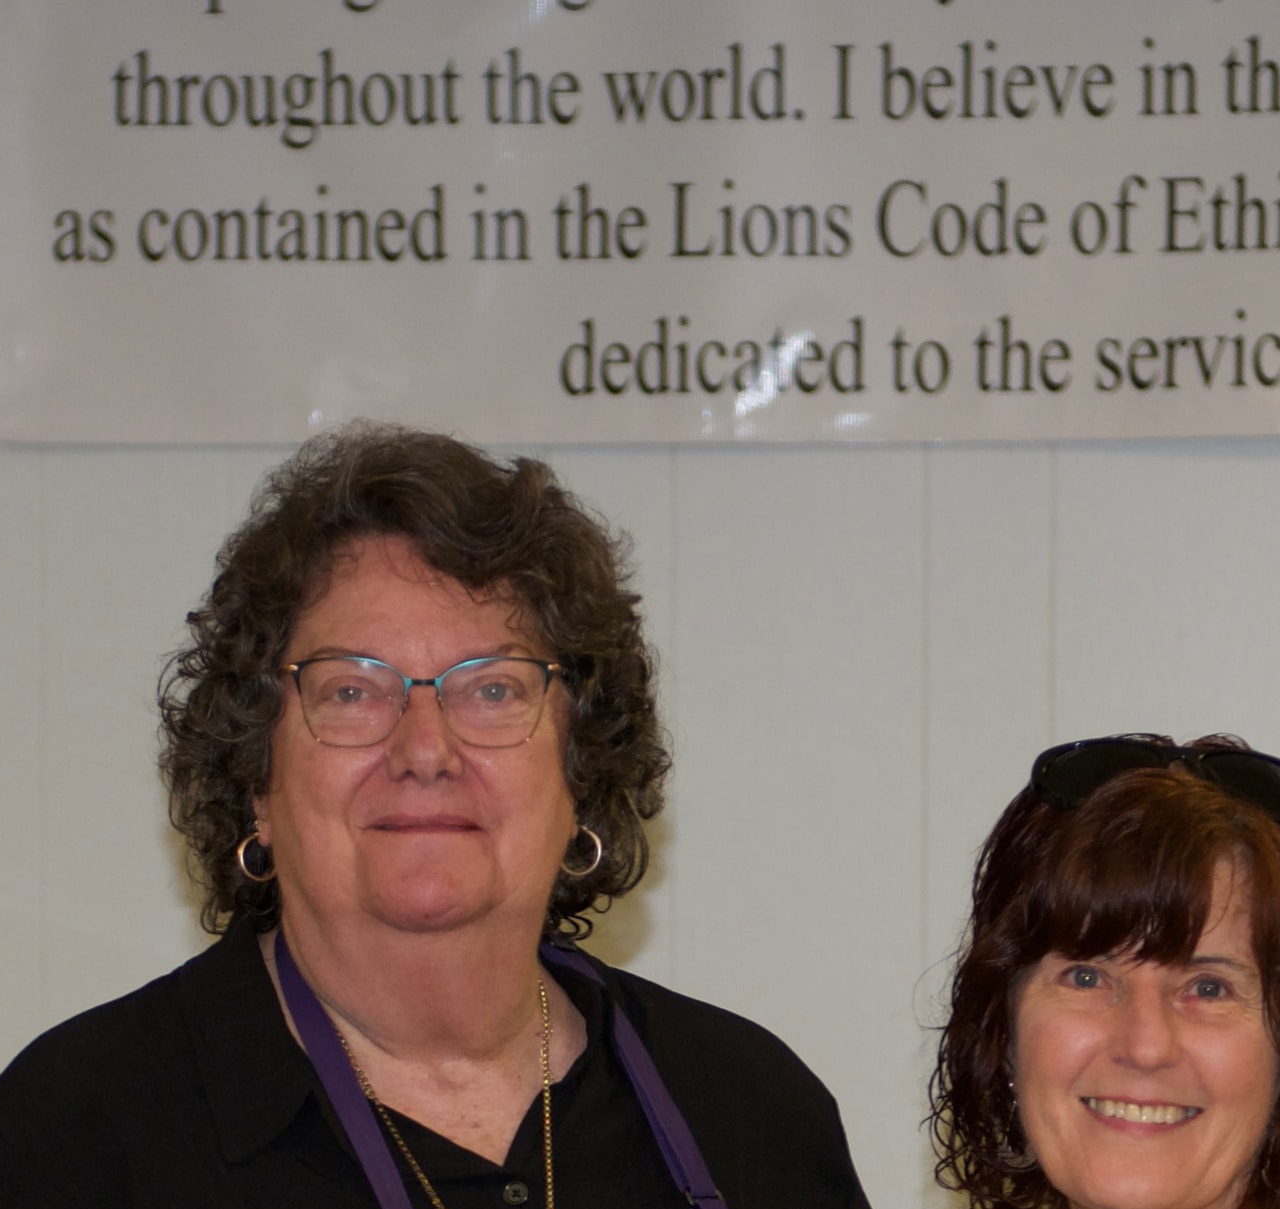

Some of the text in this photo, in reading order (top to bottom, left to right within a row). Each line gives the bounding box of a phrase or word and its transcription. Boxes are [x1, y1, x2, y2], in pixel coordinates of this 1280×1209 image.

[111, 47, 461, 151] throughout
[481, 47, 581, 127] the
[602, 42, 810, 125] world.
[832, 44, 855, 121] I
[879, 40, 1115, 121] believe
[1138, 37, 1199, 117] in
[52, 209, 117, 264] as
[137, 183, 449, 264] contained
[472, 183, 531, 262] in
[554, 182, 649, 262] the
[668, 179, 853, 259] Lions
[876, 177, 1049, 259] Code
[1069, 174, 1148, 257] of
[558, 314, 866, 397] dedicated
[889, 332, 952, 395] to
[974, 314, 1072, 393] the
